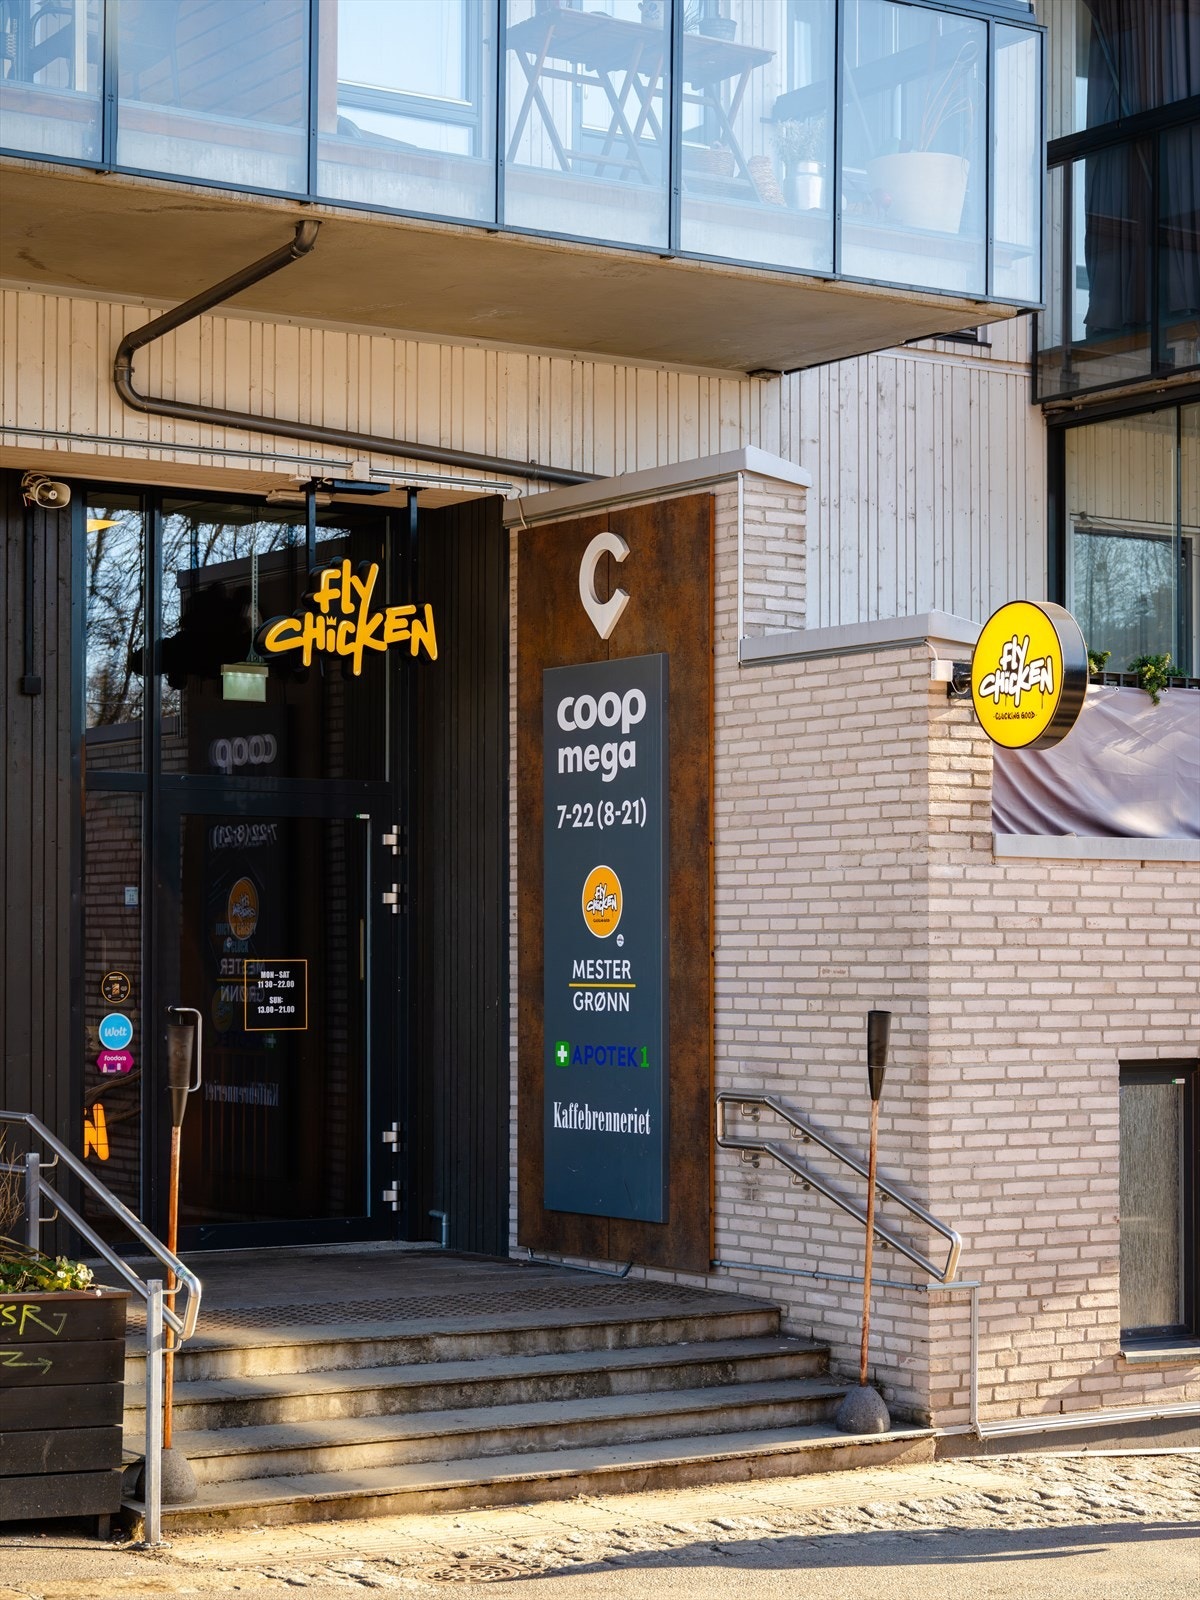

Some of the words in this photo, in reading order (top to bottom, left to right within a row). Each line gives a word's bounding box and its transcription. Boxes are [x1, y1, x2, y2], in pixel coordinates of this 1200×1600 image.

[557, 688, 646, 734] coop
[558, 741, 636, 783] mega
[557, 803, 594, 829] 7-22
[598, 797, 647, 830] (8-21)
[572, 958, 632, 980] MESTER
[573, 991, 630, 1012] GRØNN
[104, 1026, 128, 1037] Wolt
[553, 1102, 651, 1136] Kaffebrenneriet
